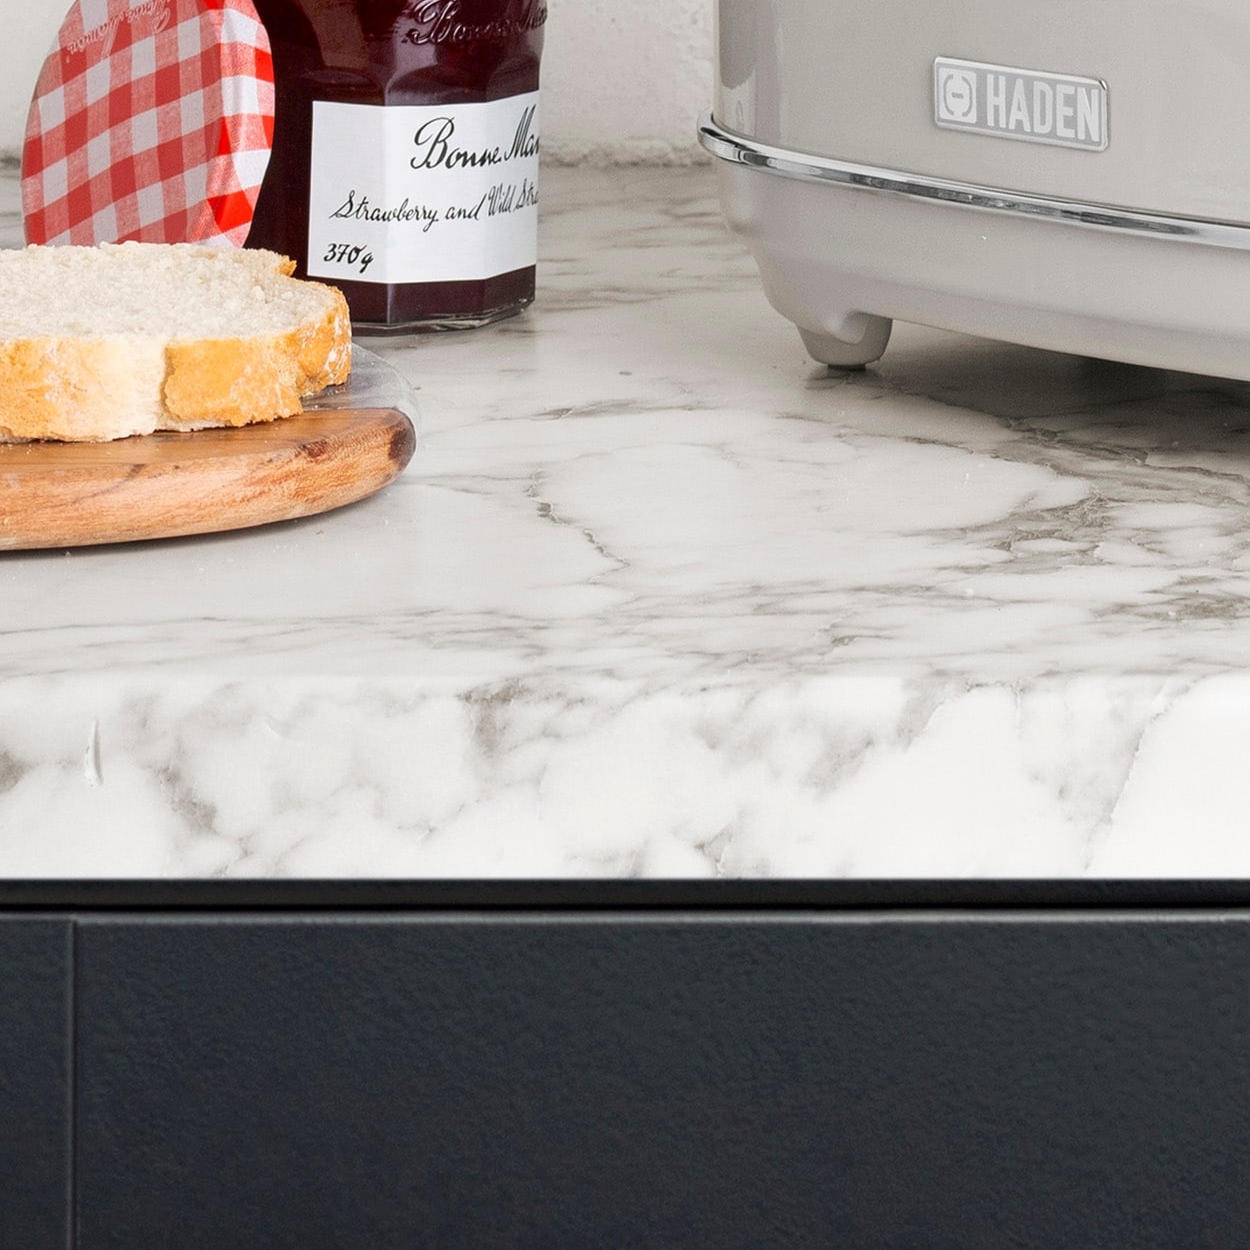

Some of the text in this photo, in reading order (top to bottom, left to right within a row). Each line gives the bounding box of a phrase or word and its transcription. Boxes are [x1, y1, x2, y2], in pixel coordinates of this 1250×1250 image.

[986, 73, 1100, 143] HADEN
[410, 116, 502, 170] Bonne
[328, 189, 439, 233] Strawberry
[445, 193, 487, 221] and
[487, 181, 516, 217] Wild
